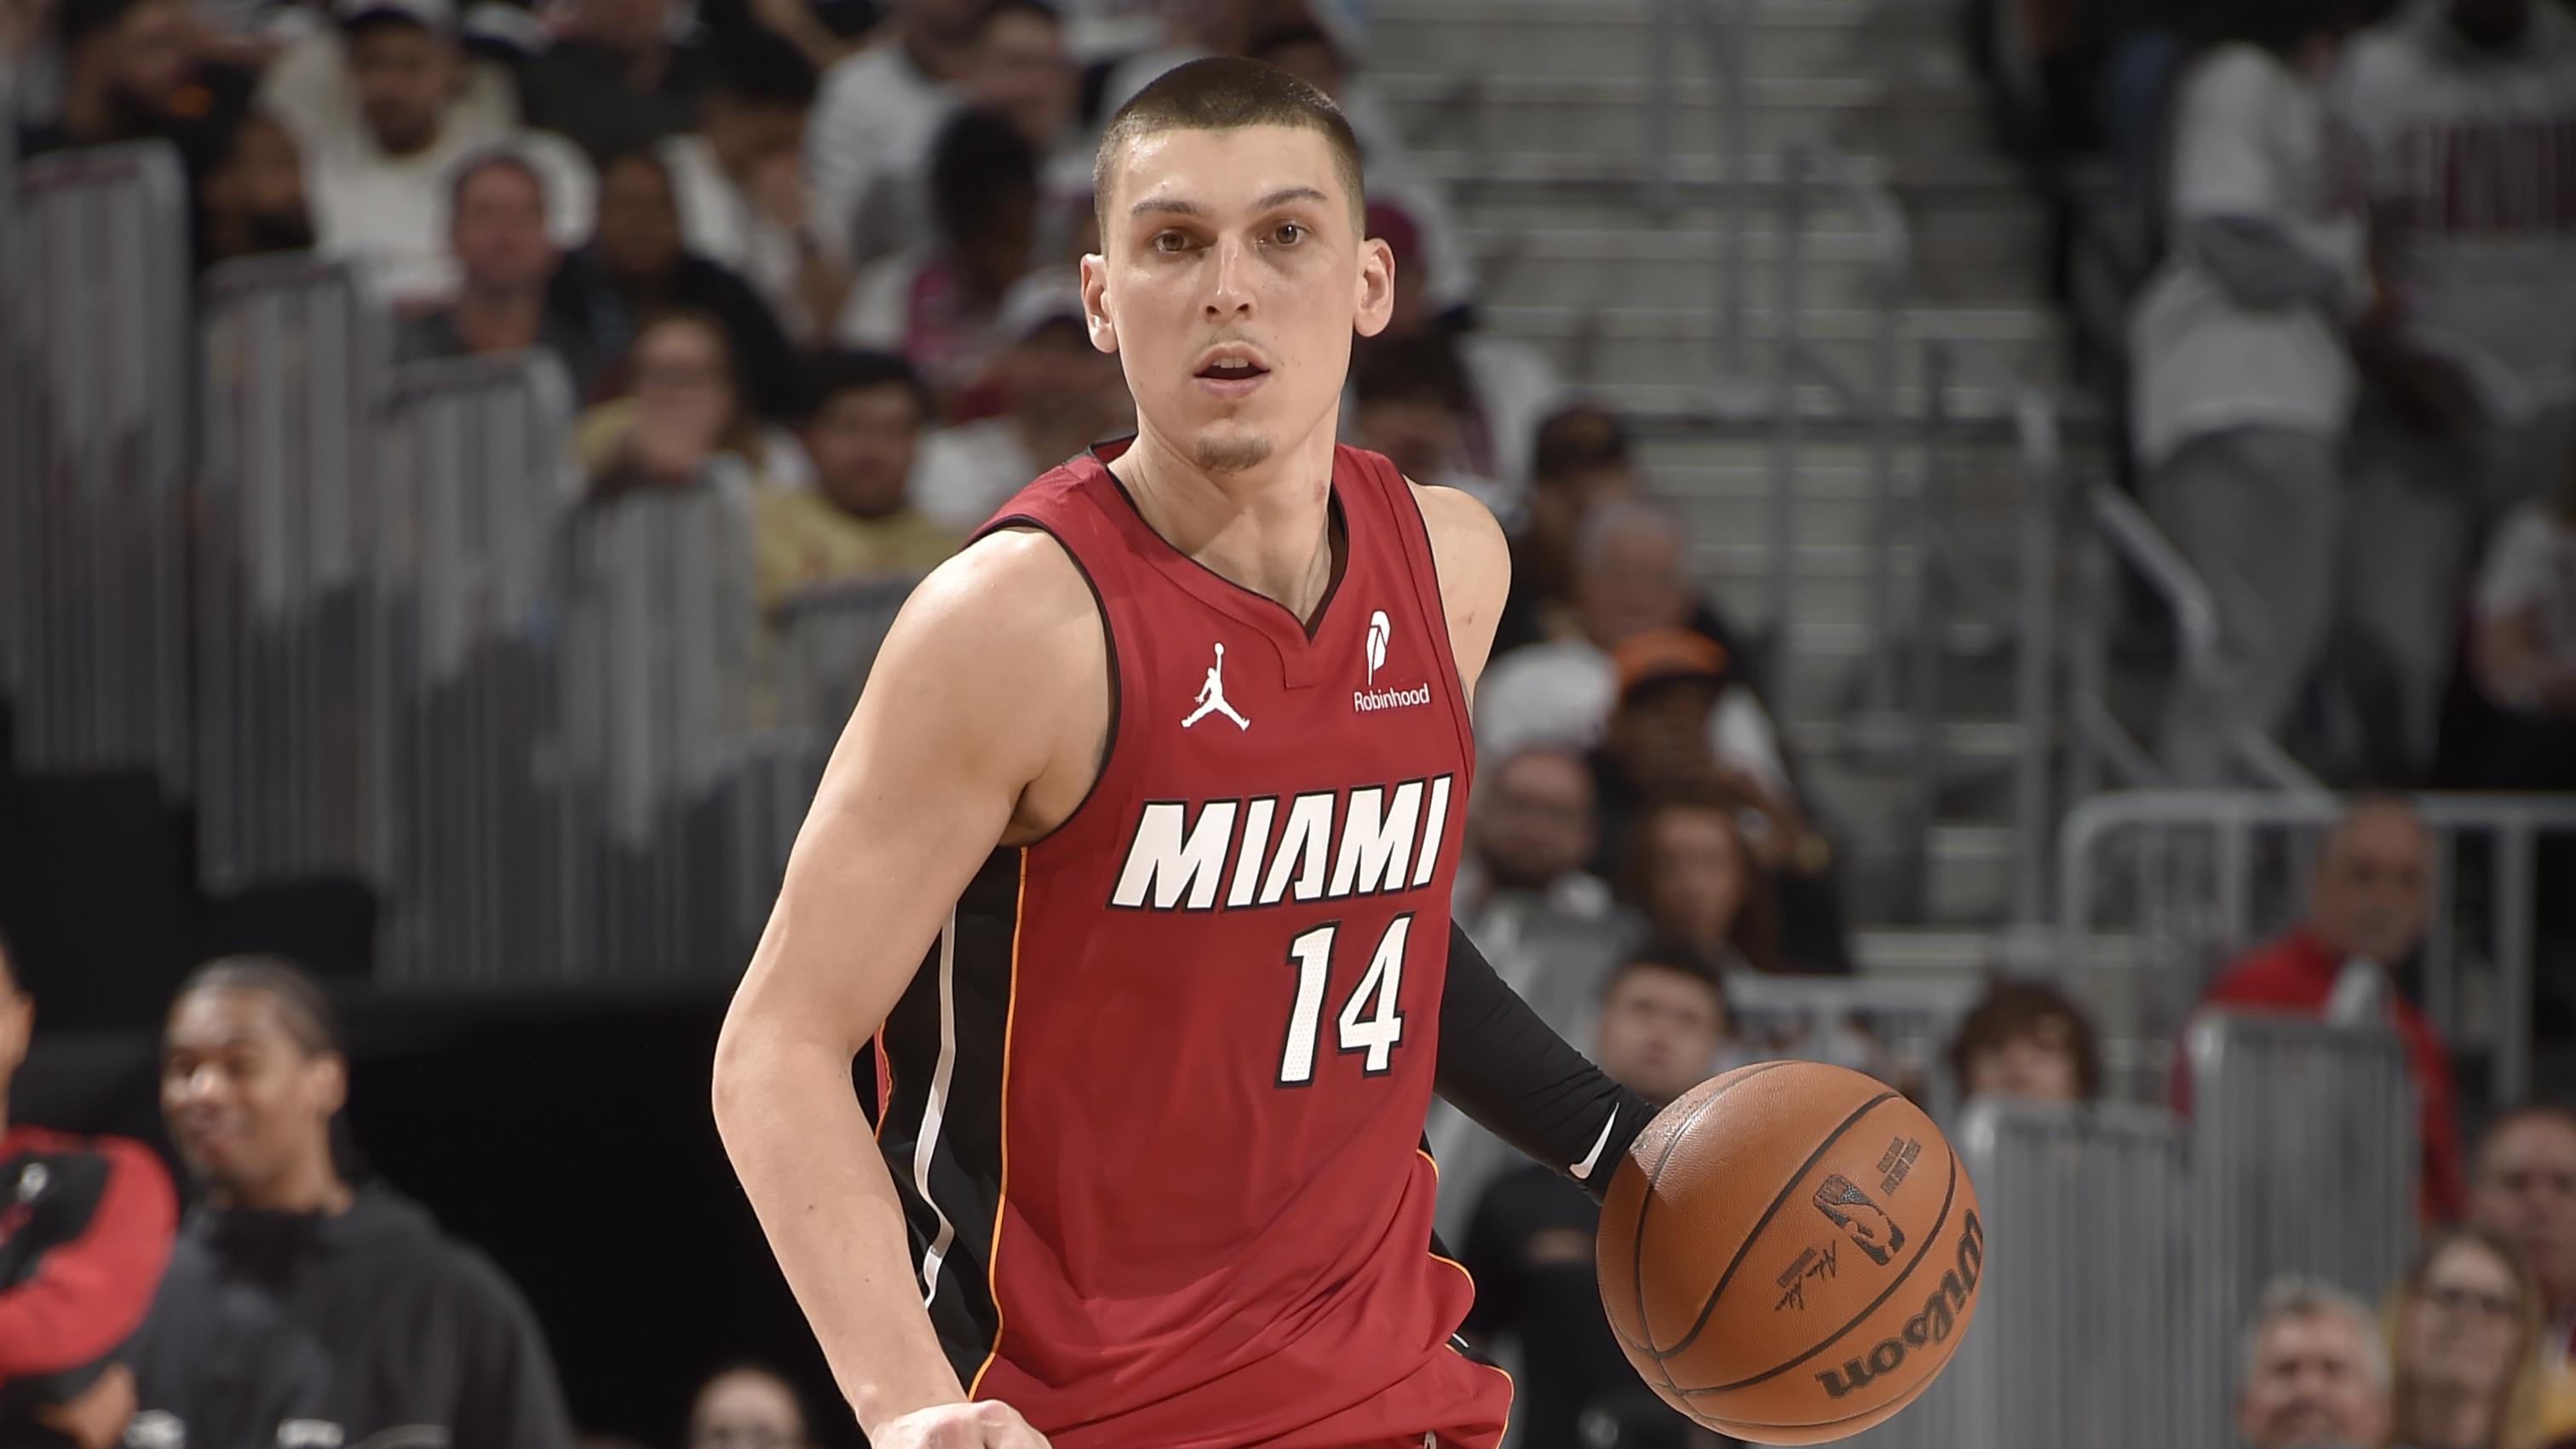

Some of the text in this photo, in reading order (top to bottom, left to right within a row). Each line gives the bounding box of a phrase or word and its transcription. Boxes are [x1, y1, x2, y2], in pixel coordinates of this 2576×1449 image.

[1354, 681, 1430, 712] Robinhood
[1108, 773, 1453, 911] MIAMI
[1275, 911, 1414, 1088] 14
[1814, 1208, 1983, 1400] Wilson
